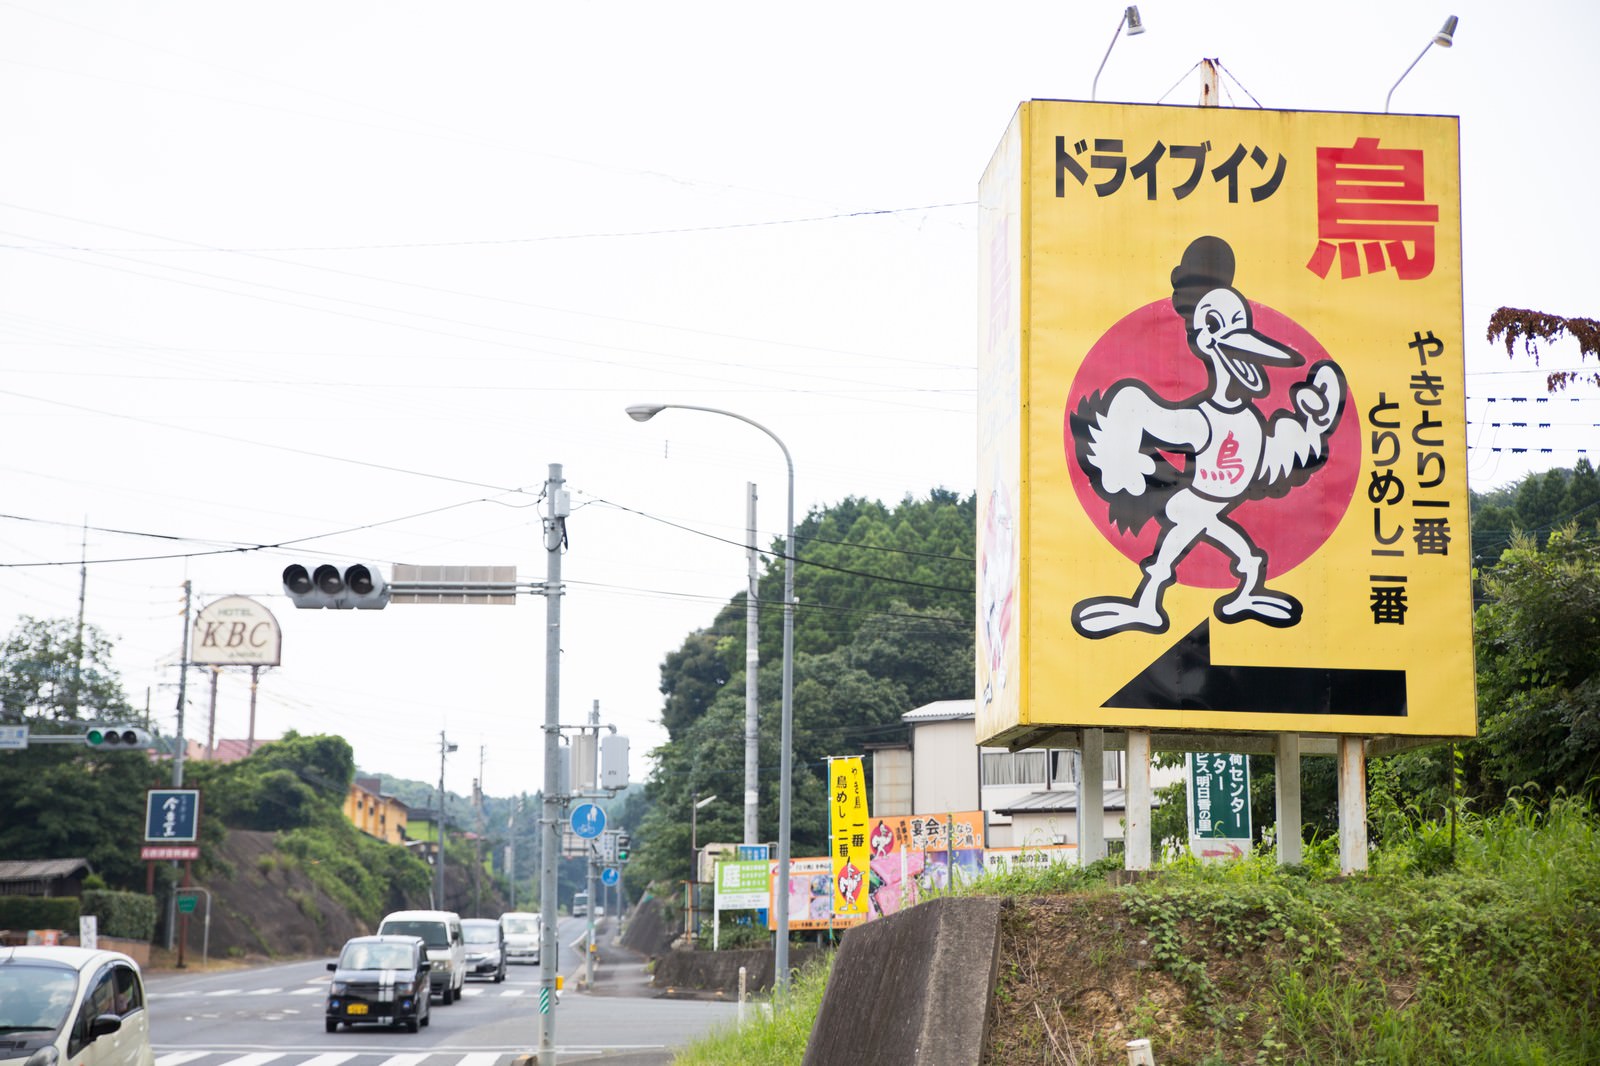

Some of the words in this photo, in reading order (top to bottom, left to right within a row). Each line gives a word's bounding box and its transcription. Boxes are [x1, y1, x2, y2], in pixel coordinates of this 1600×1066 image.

[1055, 136, 1287, 203] ドライブイン
[1306, 137, 1439, 281] 鳥
[1200, 430, 1245, 485] 鳥
[1408, 330, 1451, 556] やきとり一番
[1367, 392, 1408, 625] とりめし二番
[201, 621, 271, 648] KBC
[217, 608, 254, 617] HOTEL
[1213, 752, 1227, 791] ター
